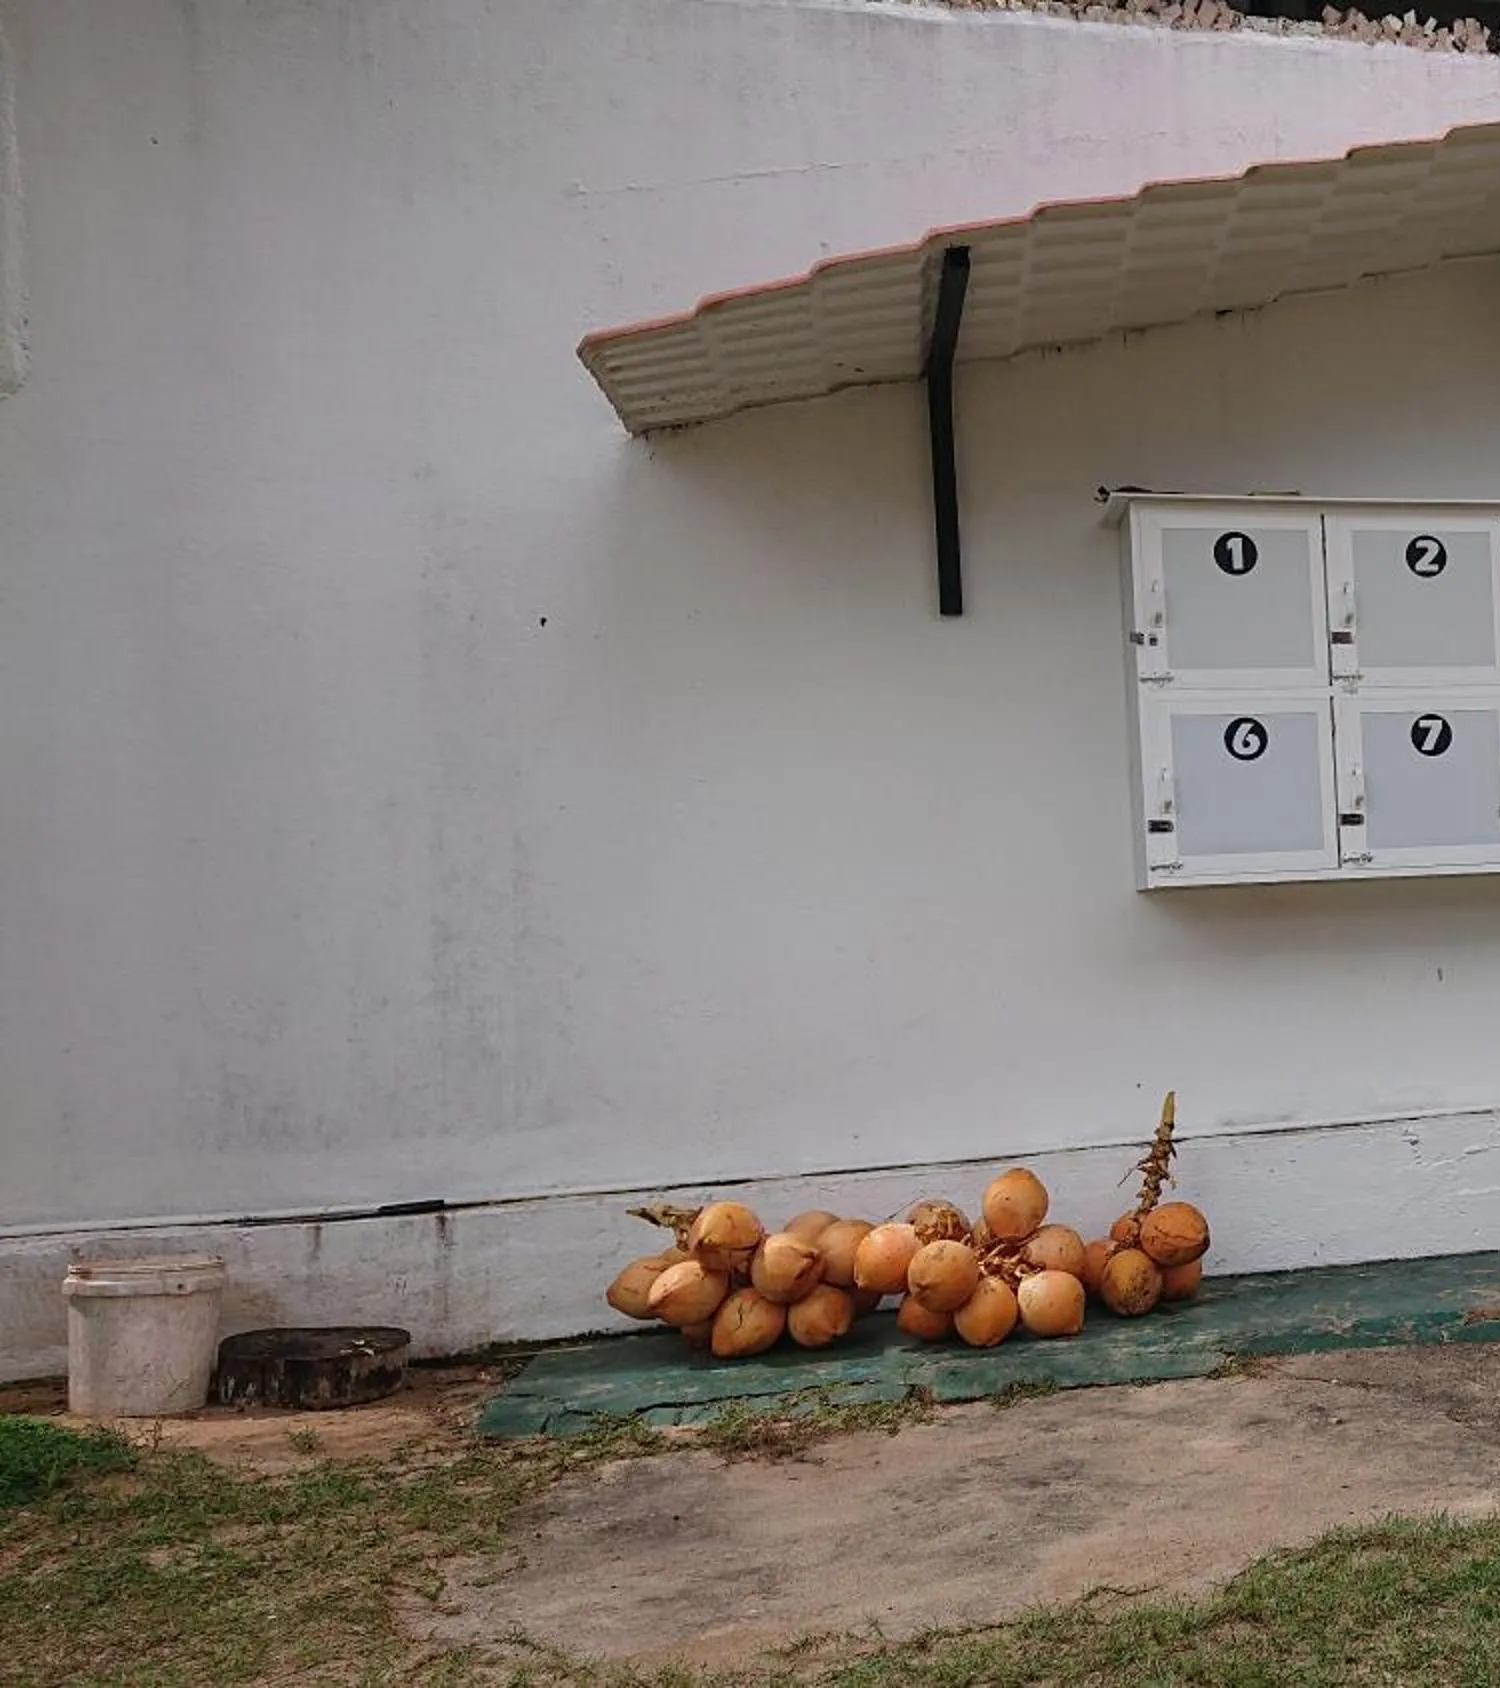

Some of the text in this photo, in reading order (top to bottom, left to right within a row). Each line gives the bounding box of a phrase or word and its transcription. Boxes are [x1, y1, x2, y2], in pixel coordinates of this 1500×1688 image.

[1226, 537, 1244, 570] 1
[1415, 539, 1440, 572] 2
[1232, 723, 1261, 755] 6
[1418, 719, 1443, 751] 7
